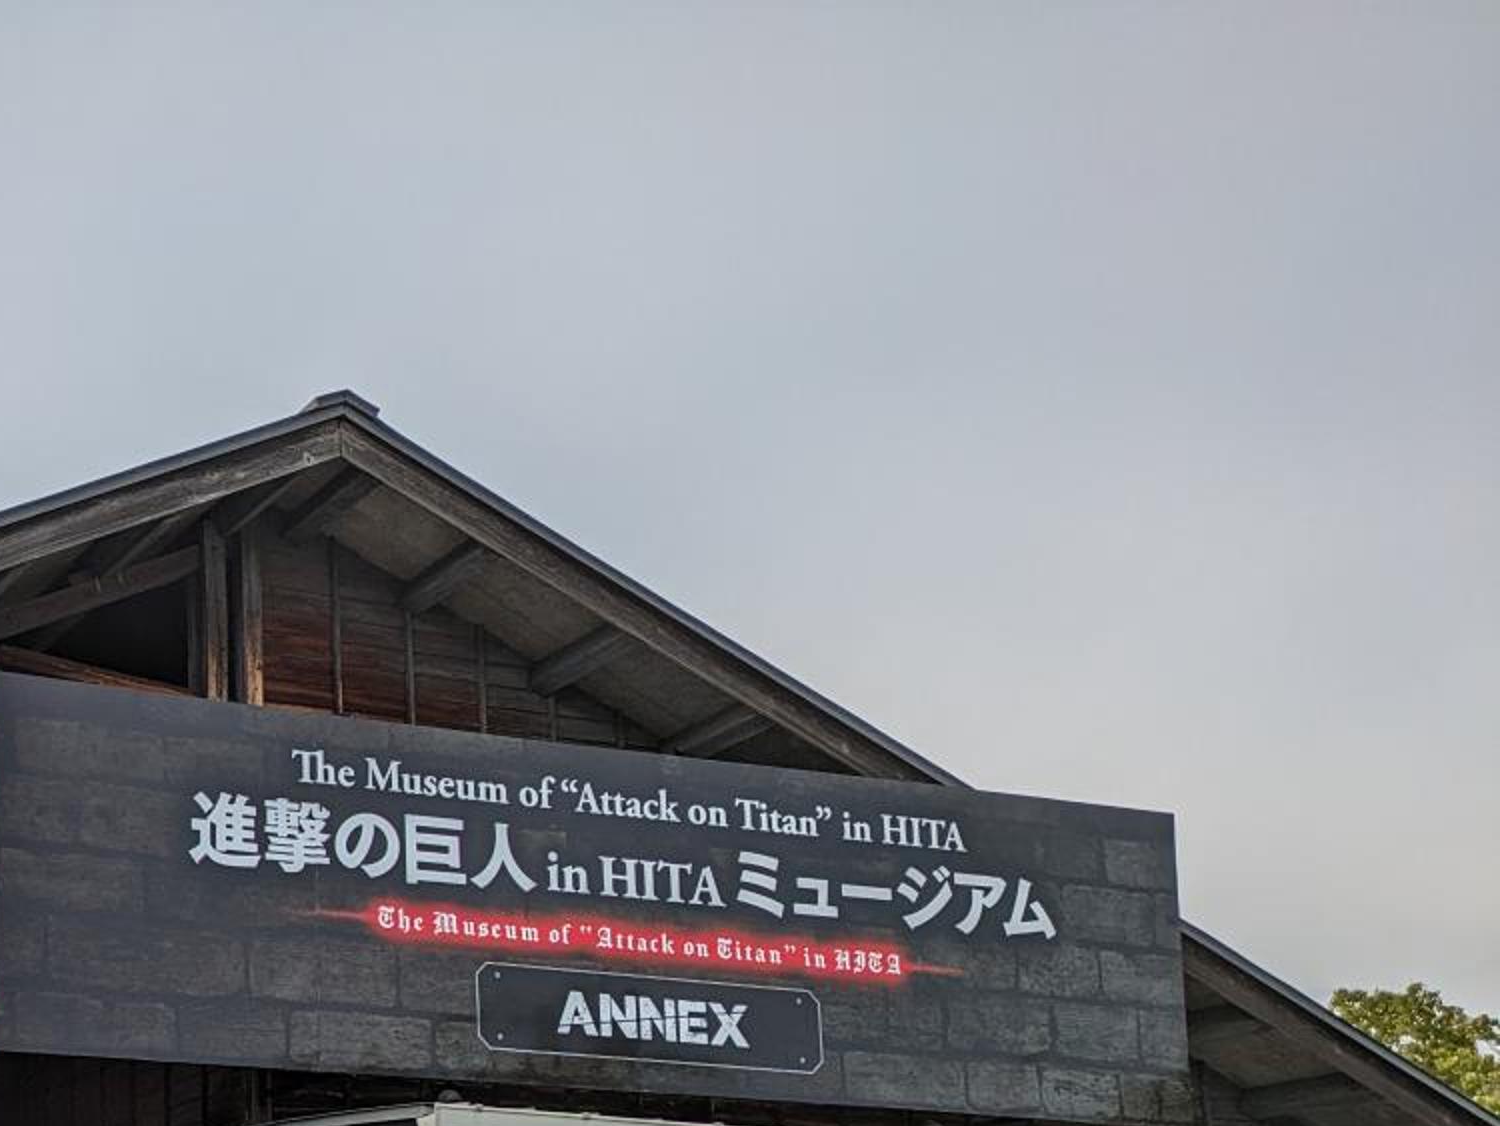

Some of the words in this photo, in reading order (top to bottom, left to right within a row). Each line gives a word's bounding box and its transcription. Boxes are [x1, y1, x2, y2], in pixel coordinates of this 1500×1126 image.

[292, 749, 356, 787] The
[365, 757, 510, 805] Museum
[518, 776, 555, 809] of
[561, 778, 681, 824] “Attack
[687, 804, 728, 828] on
[735, 797, 833, 838] Titan”
[842, 811, 874, 844] in
[880, 813, 969, 853] HITA
[189, 791, 539, 894] 進撃の巨人
[546, 851, 591, 895] in
[600, 855, 727, 908] HITA
[736, 850, 1058, 941] ミュージアム
[377, 905, 425, 934] The
[433, 911, 541, 943] Museum
[548, 923, 572, 946] of
[683, 939, 710, 958] on
[802, 946, 827, 969] in
[833, 948, 902, 976] HITA
[556, 989, 751, 1049] ANNEX
